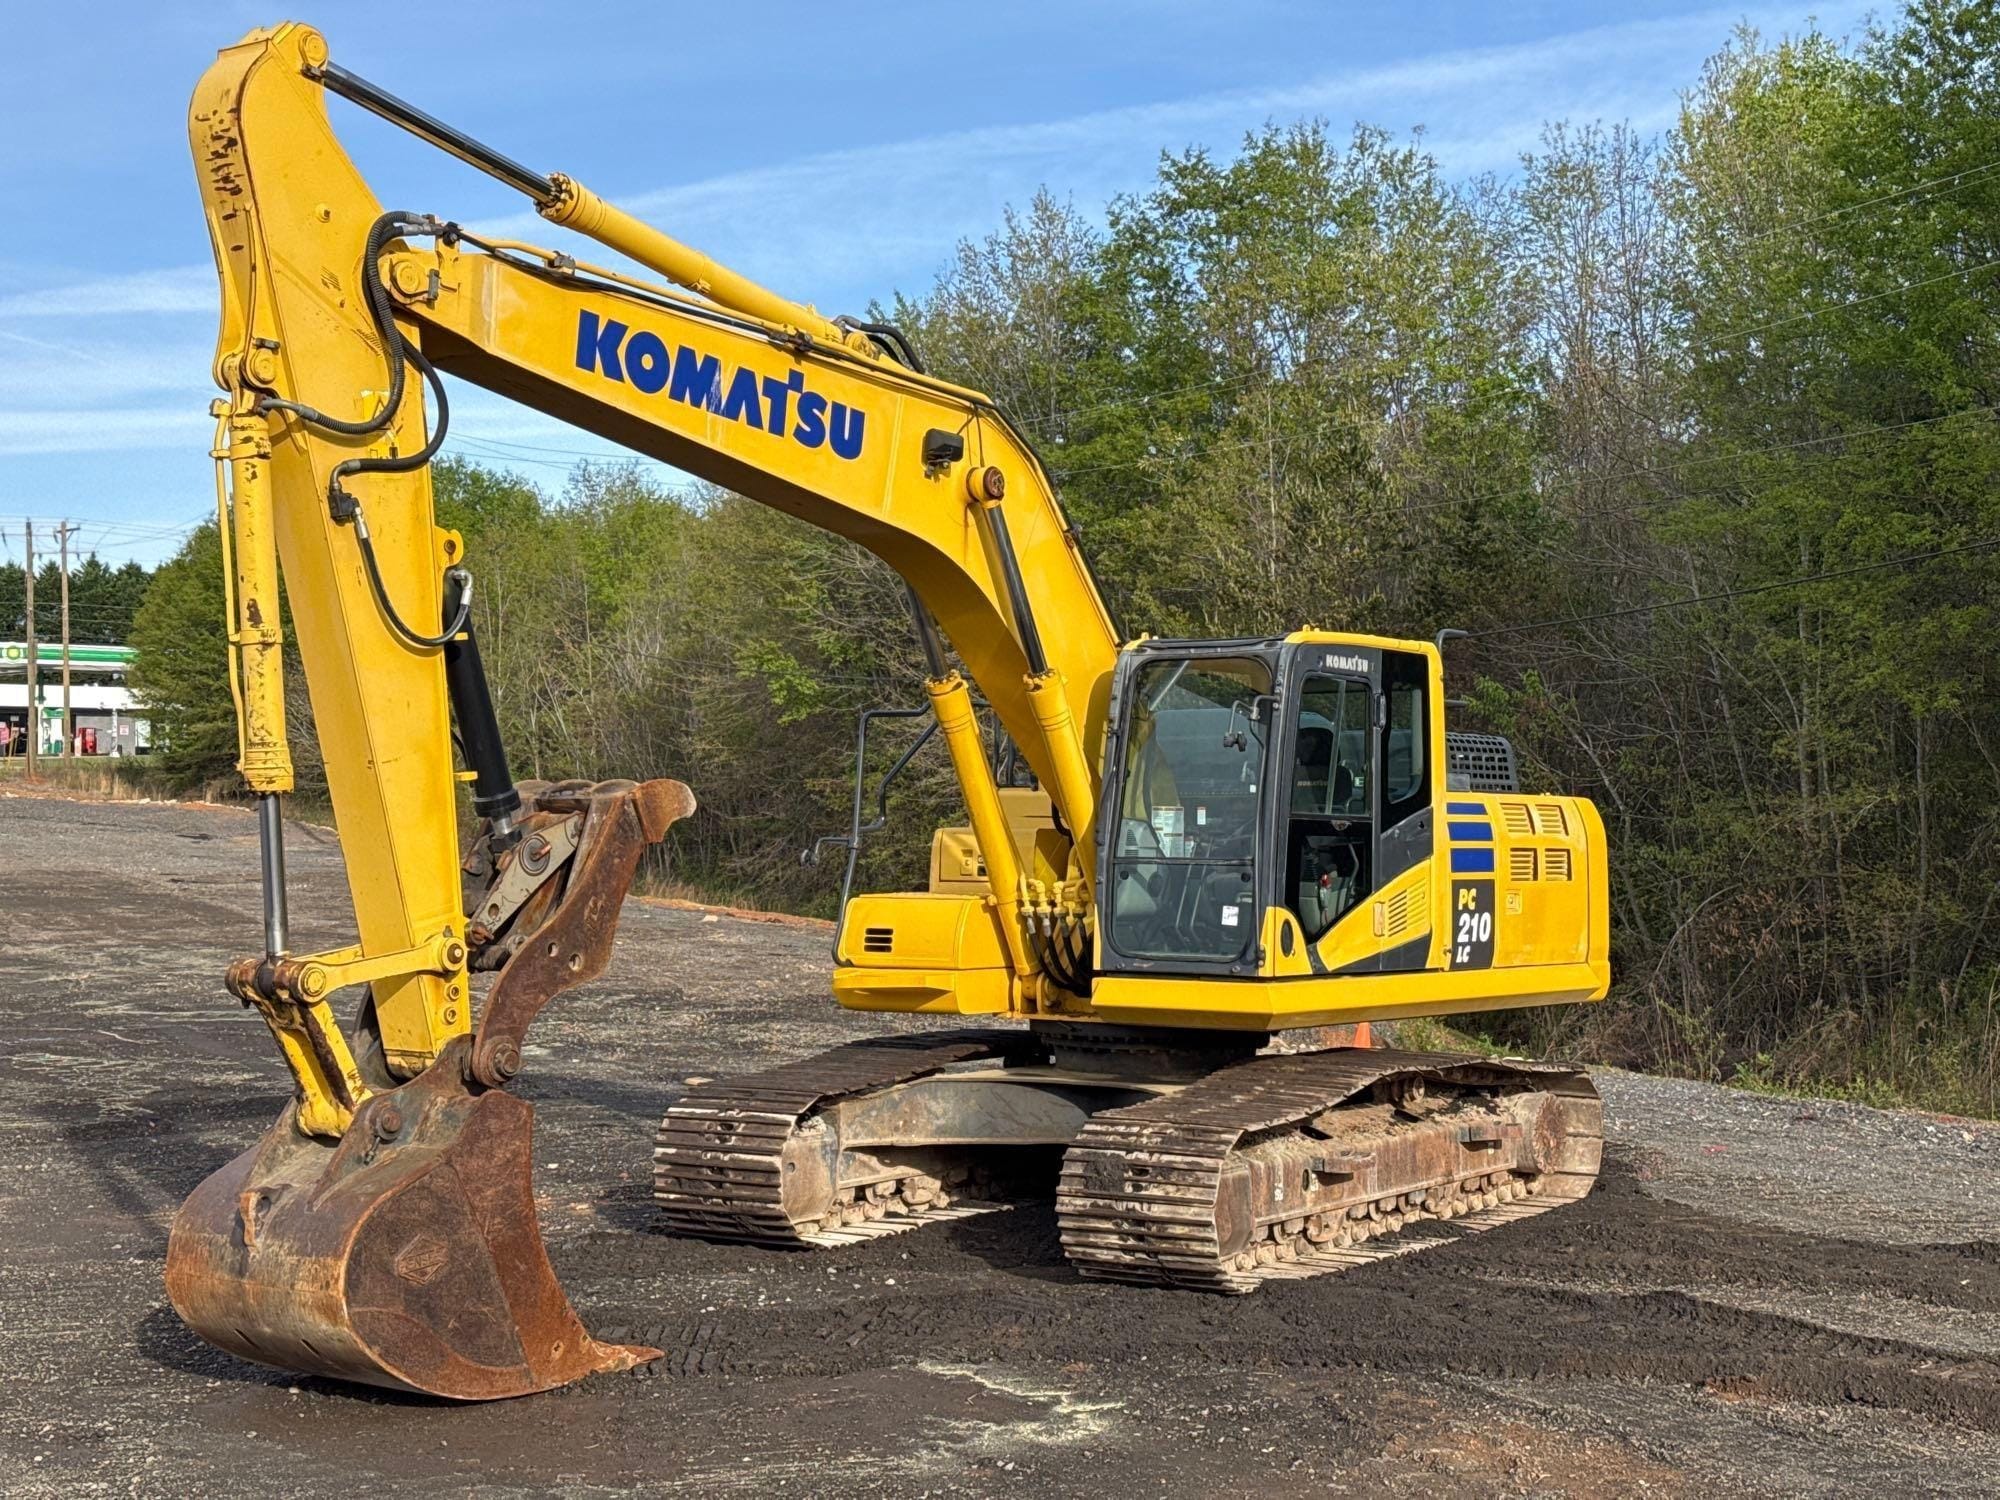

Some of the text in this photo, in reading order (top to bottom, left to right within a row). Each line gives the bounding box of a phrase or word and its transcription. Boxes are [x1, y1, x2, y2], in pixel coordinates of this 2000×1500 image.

[576, 309, 865, 460] KOMATSU
[1326, 654, 1369, 672] KOMATSU
[1458, 888, 1477, 910] PC
[1457, 912, 1491, 942] 210
[1456, 945, 1471, 963] LC
